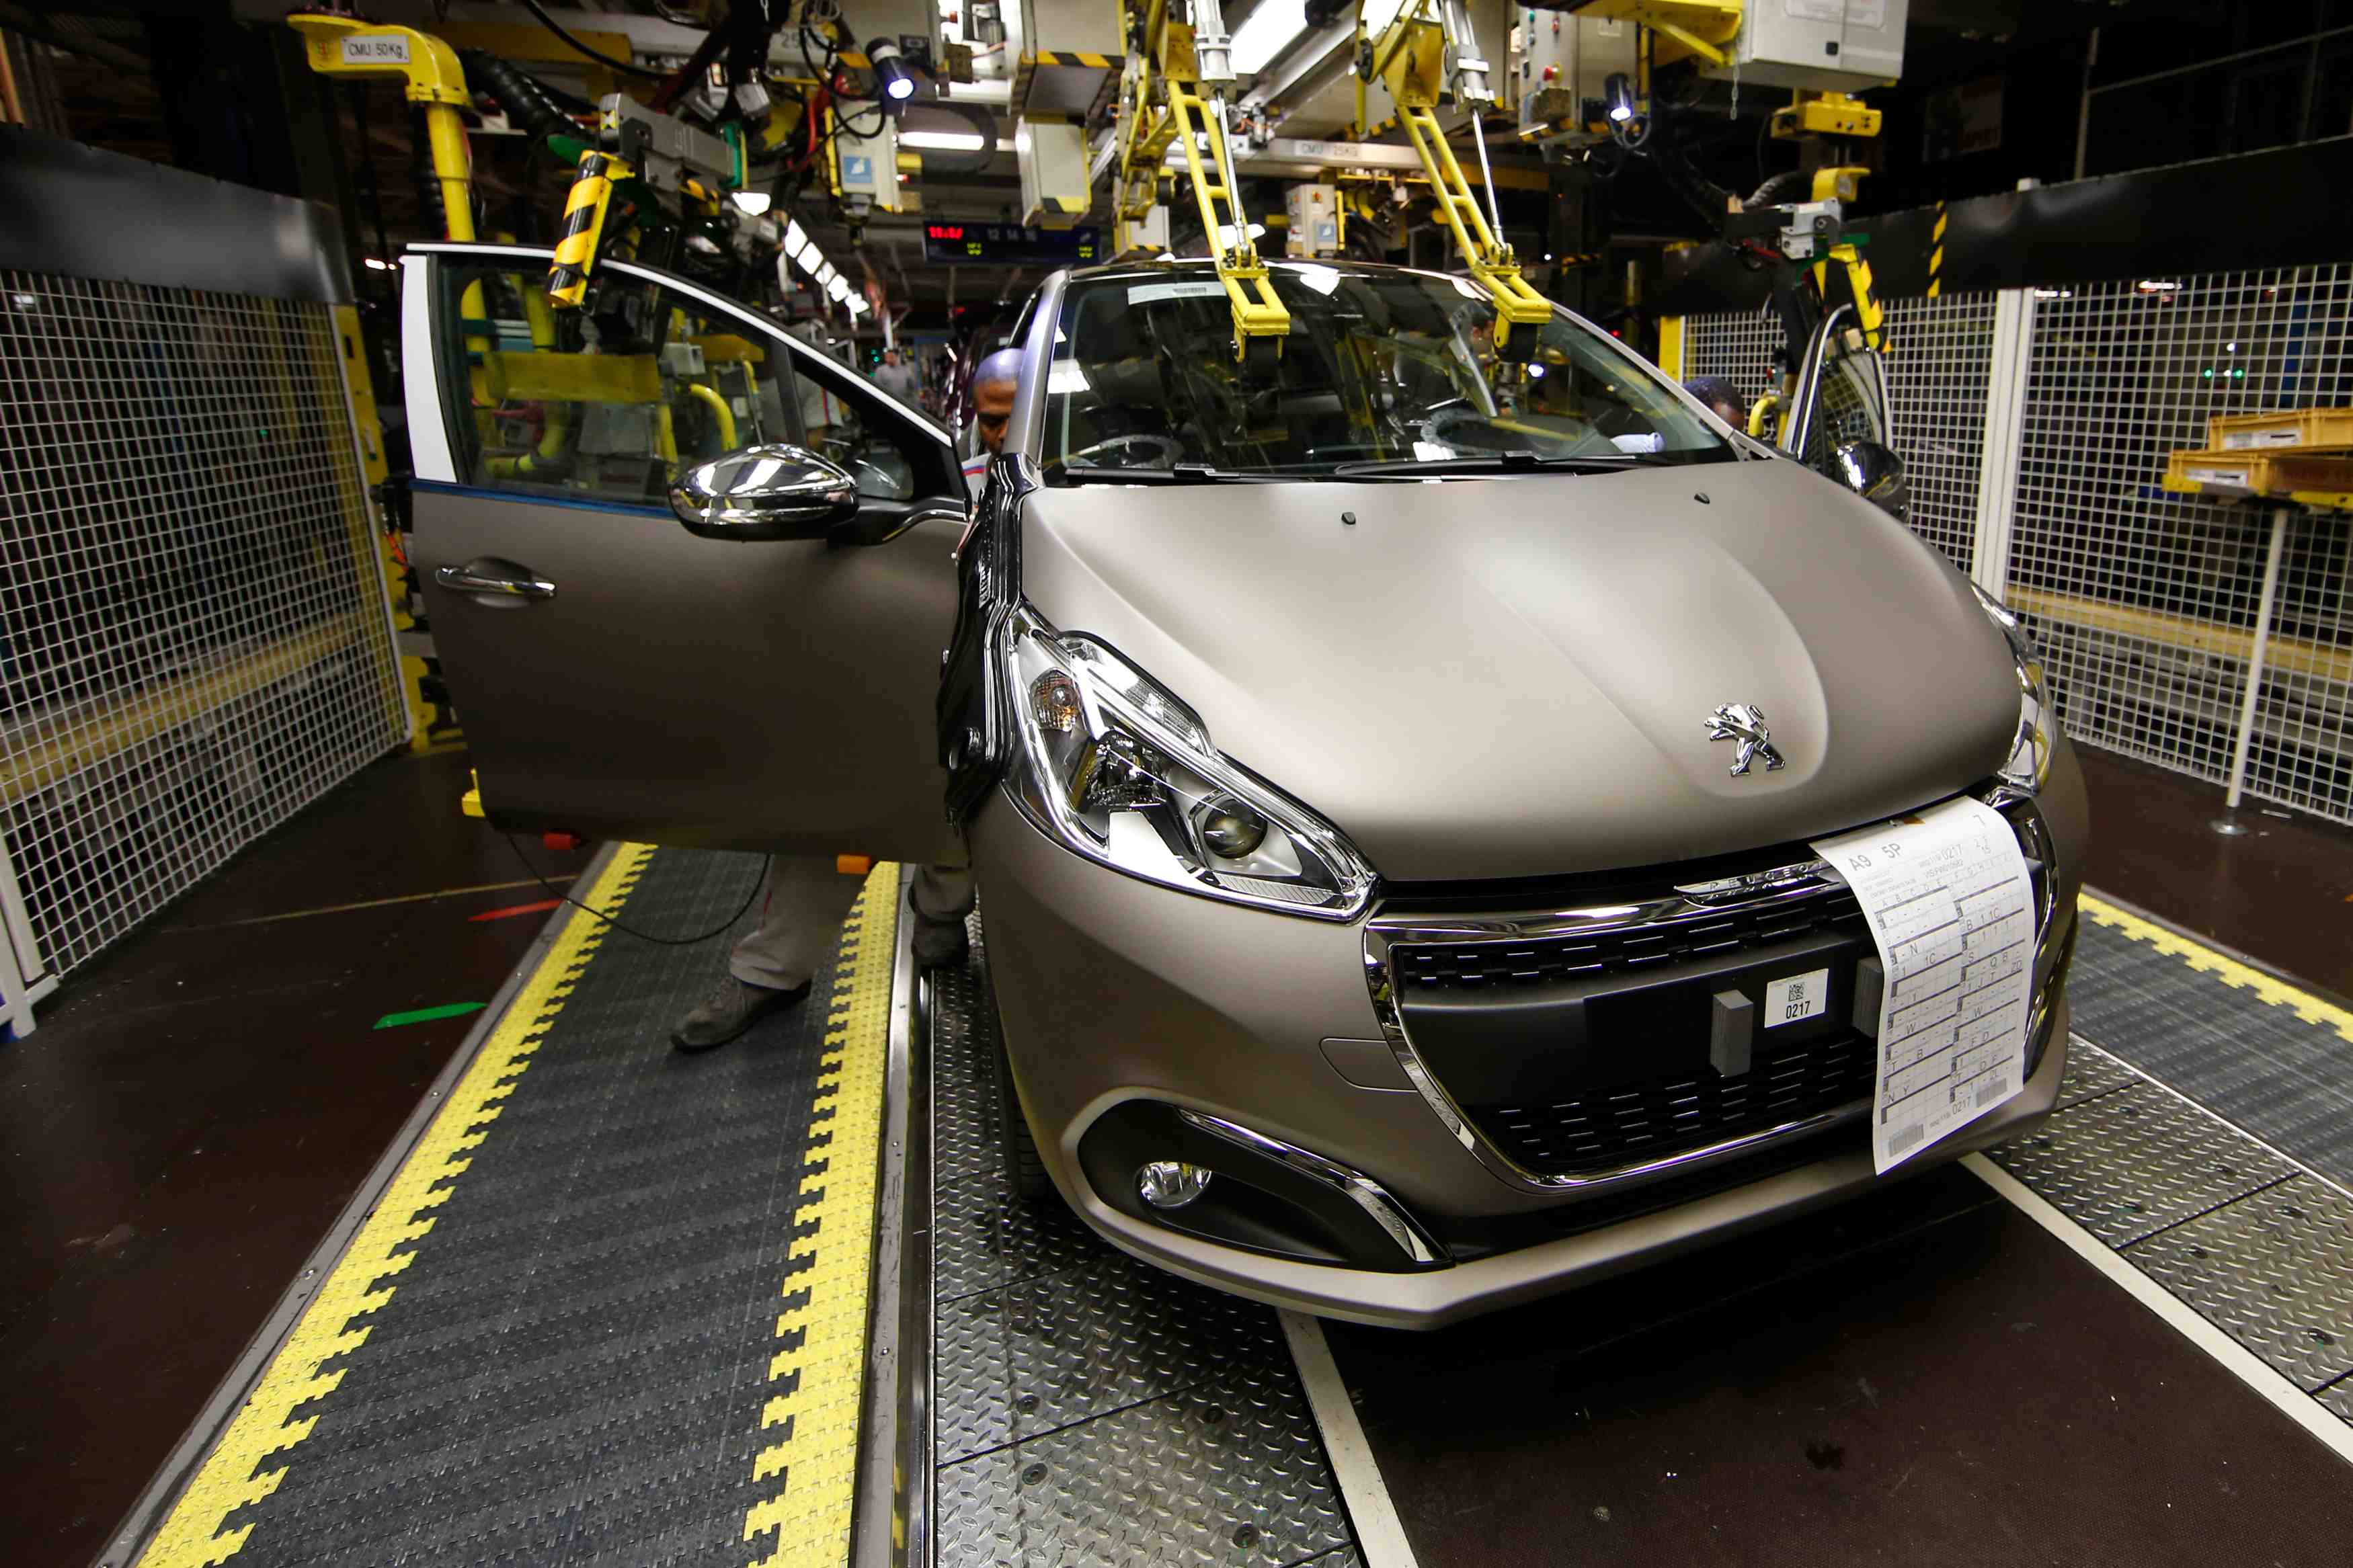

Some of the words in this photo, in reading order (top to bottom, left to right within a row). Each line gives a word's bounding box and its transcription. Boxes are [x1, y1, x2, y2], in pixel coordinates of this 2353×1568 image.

[348, 43, 371, 56] CMU
[1849, 854, 1872, 872] A9
[1881, 843, 1901, 859] 5P
[1941, 843, 1962, 860] 0217
[1966, 919, 1973, 931] B
[1910, 942, 1918, 954] N
[1925, 952, 1936, 966] 1C
[1786, 999, 1811, 1020] 0217
[1906, 1022, 1916, 1035] W
[1952, 1095, 1971, 1115] 0217
